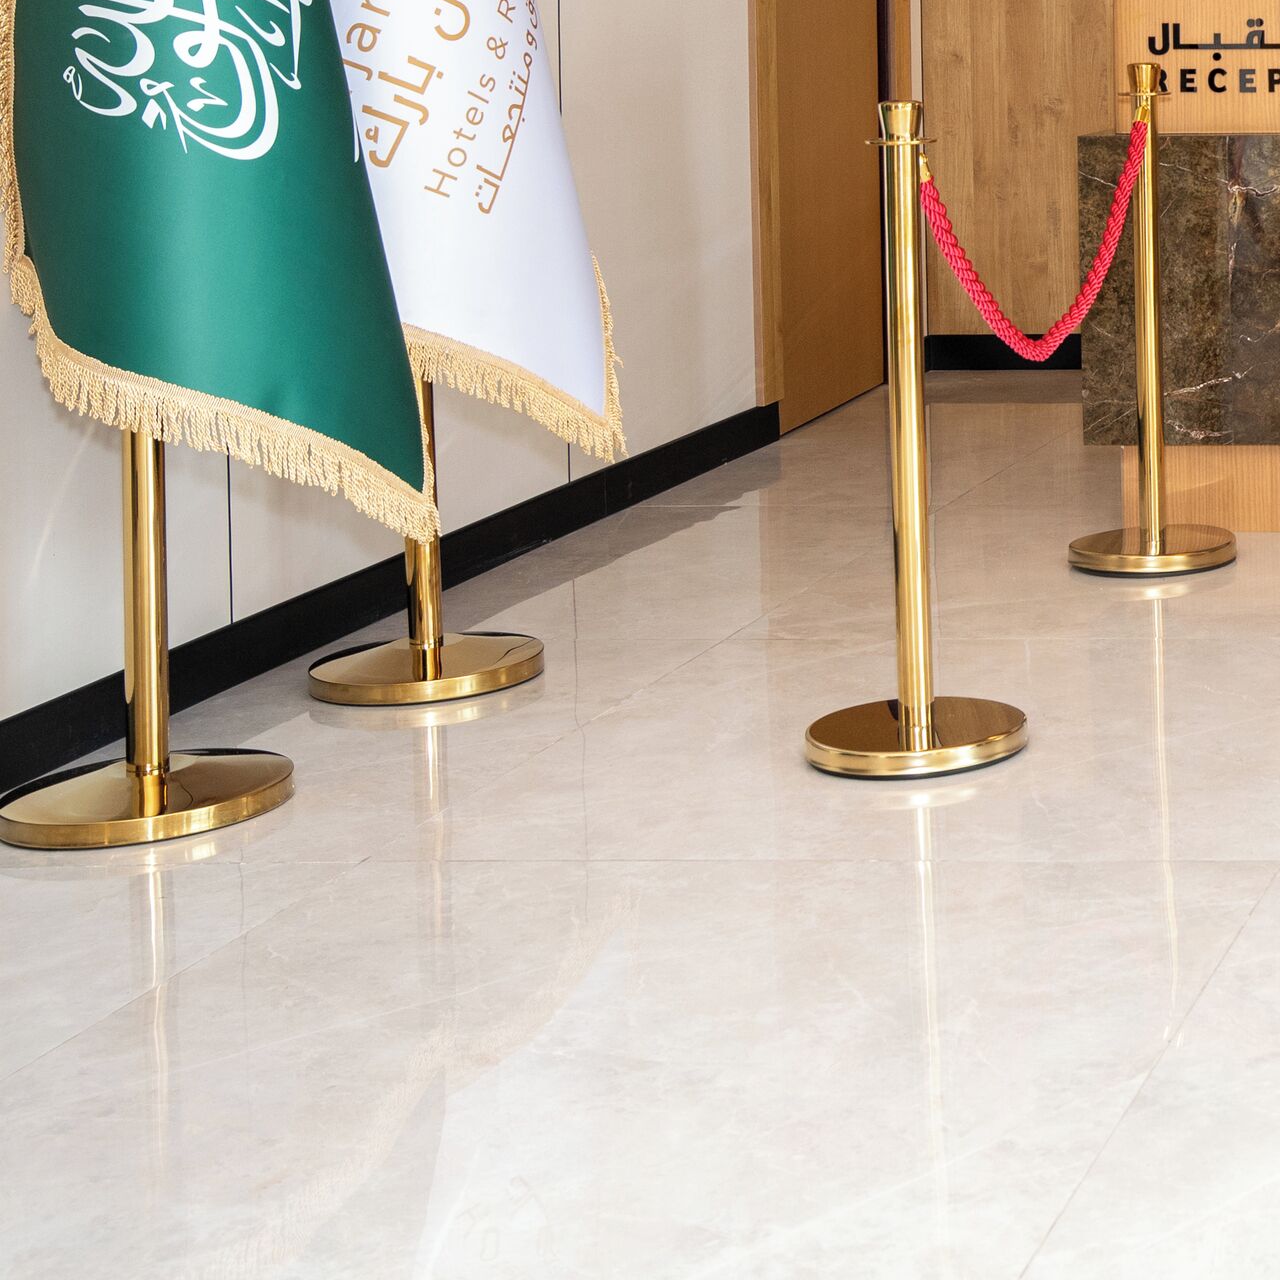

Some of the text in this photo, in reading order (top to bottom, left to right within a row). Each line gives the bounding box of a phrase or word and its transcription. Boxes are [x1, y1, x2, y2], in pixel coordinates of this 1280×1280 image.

[362, 55, 444, 167] بارك
[424, 74, 496, 197] Hotels
[486, 36, 508, 60] &
